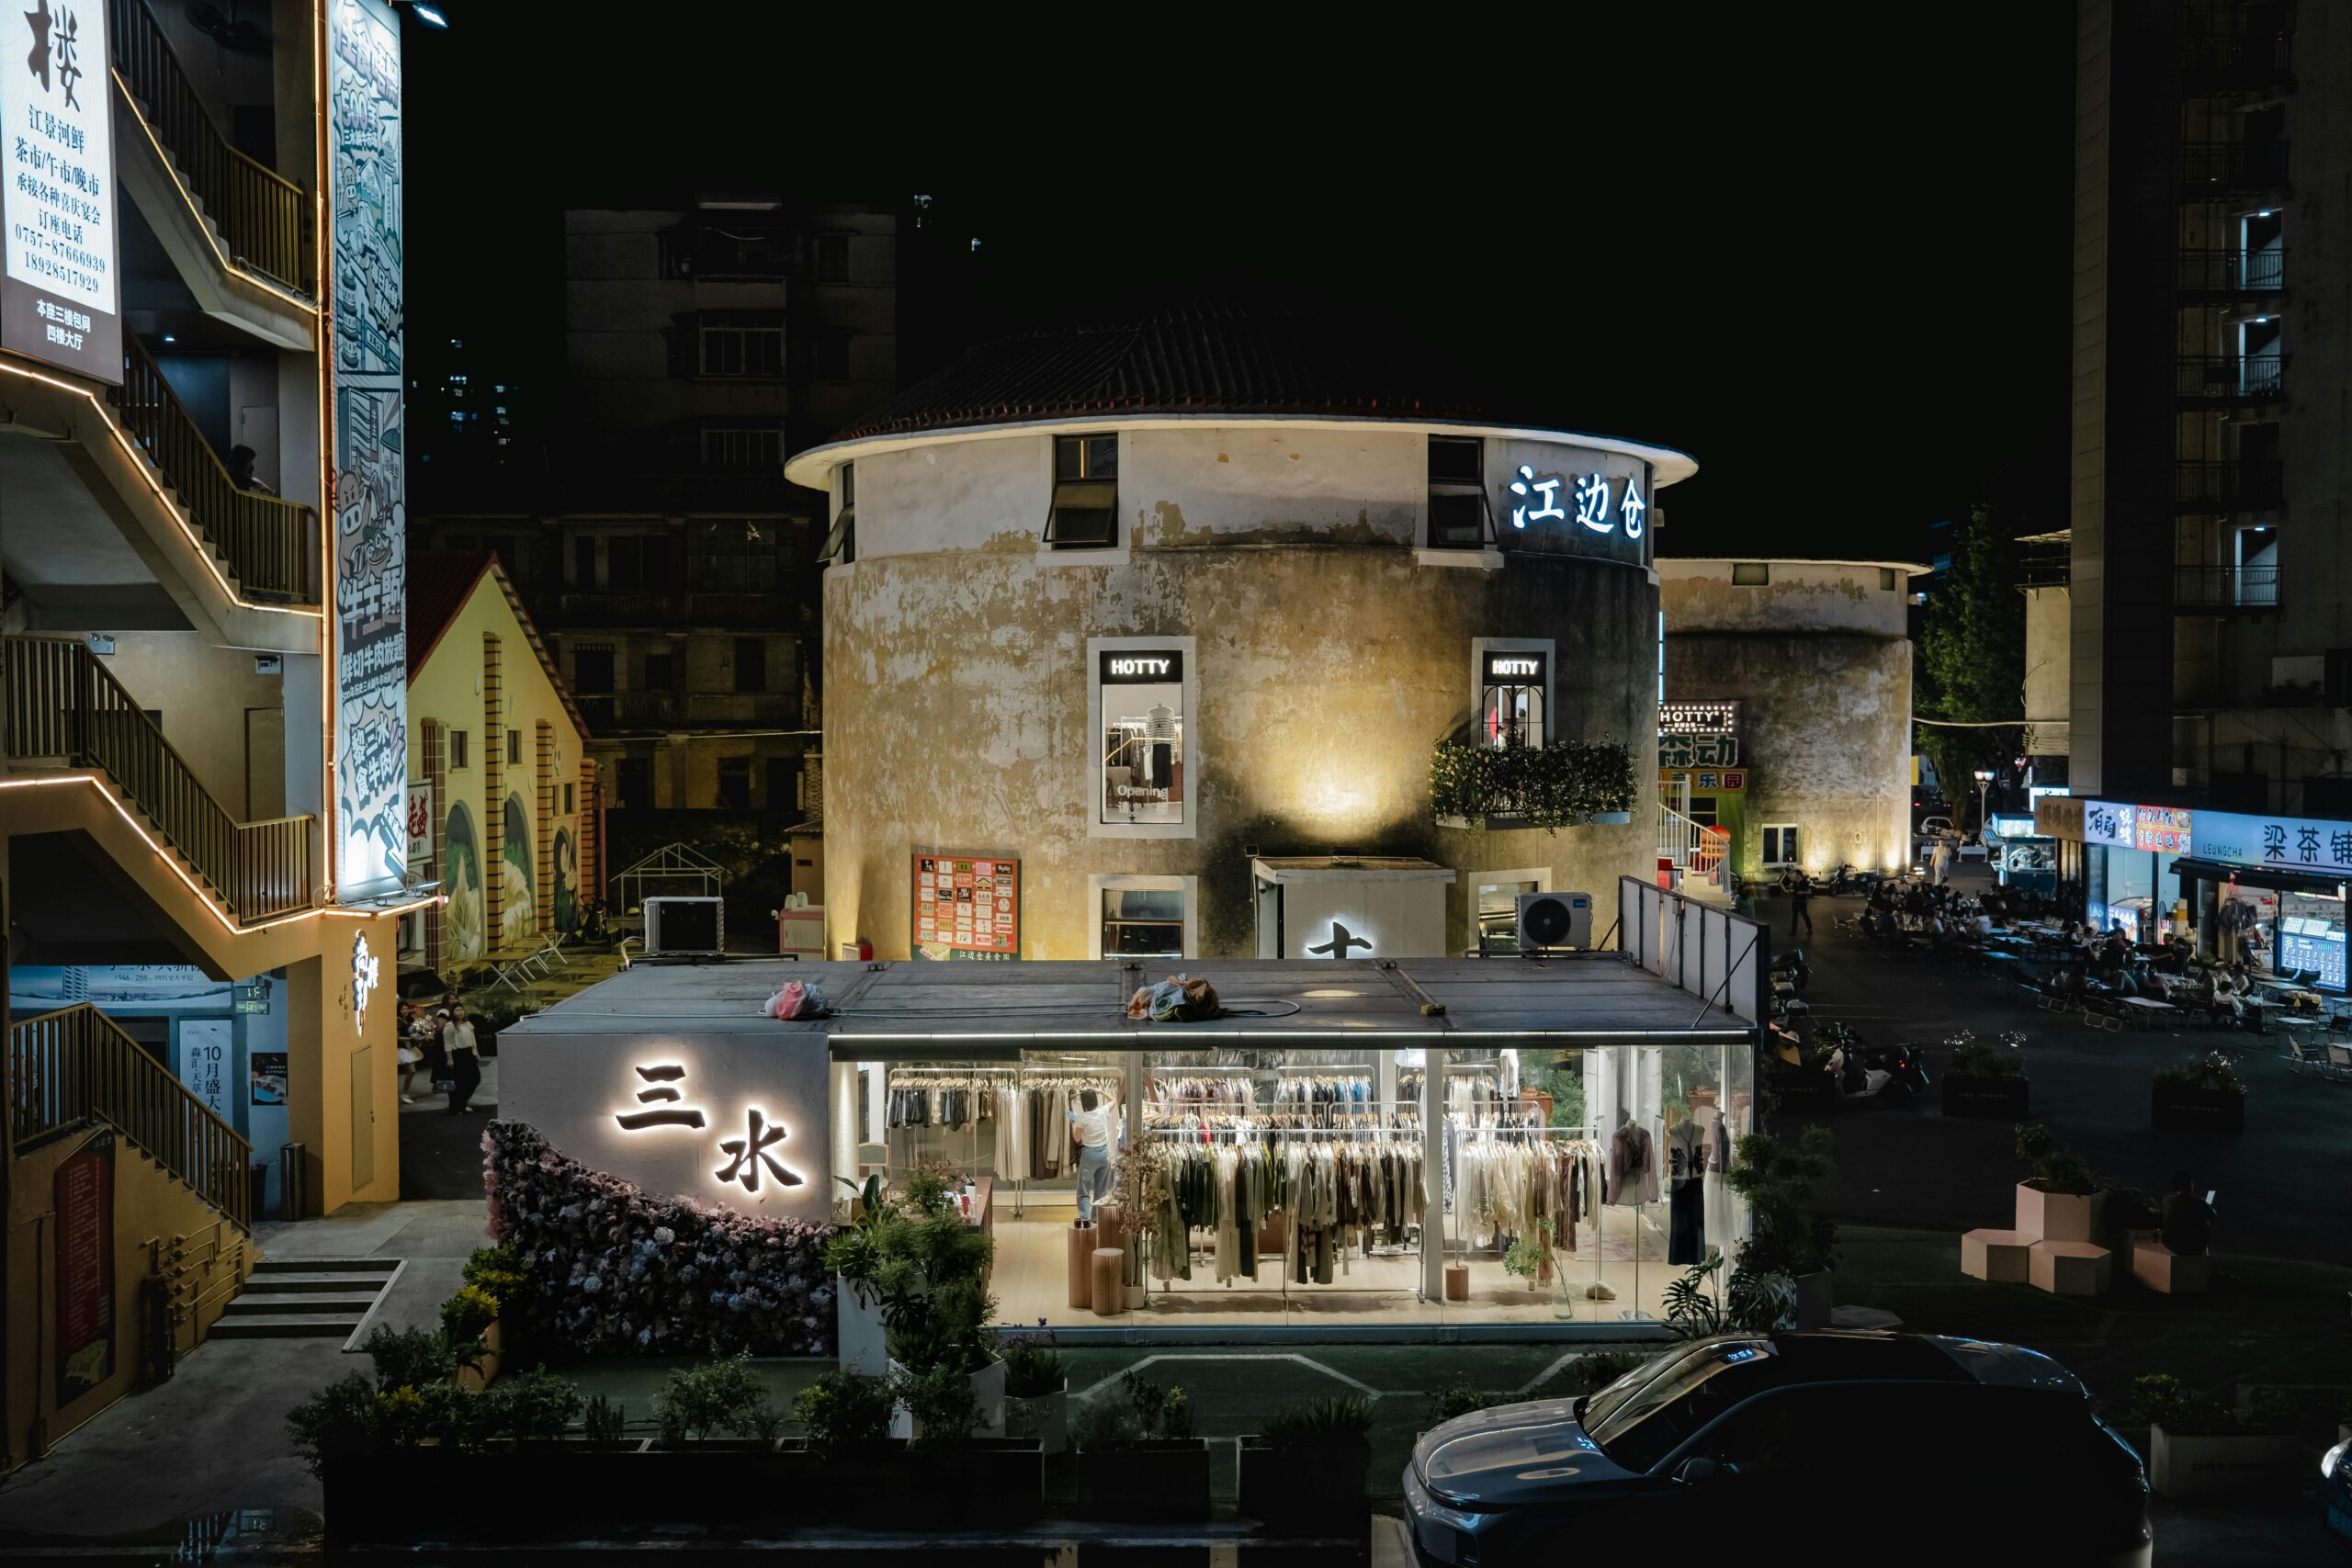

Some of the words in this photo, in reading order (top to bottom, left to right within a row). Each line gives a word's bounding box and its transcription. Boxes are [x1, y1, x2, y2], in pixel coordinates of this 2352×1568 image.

[24, 0, 82, 112] 楼
[28, 104, 85, 155] 江景河鲜
[15, 136, 99, 197] 茶市/午市/晚市
[17, 172, 101, 227] 承接各种喜庆宴会
[15, 223, 106, 275] 0757-87666939
[39, 209, 84, 245] 订座电话
[24, 252, 98, 294] 18928517929
[37, 299, 91, 333] 本座三楼包间
[47, 325, 84, 351] 四楼大厅
[1510, 465, 1645, 538] 江边仓
[343, 568, 401, 639] 牛主题
[341, 632, 404, 684] 鲜切牛肉放题
[1111, 660, 1170, 674] HOTTY
[1492, 660, 1539, 675] HOTTY
[1660, 711, 1714, 722] HOTTY
[1117, 784, 1169, 800] Opening
[2202, 843, 2243, 859] LEUNGCHA
[2264, 824, 2352, 864] 梁茶铺
[203, 1046, 221, 1118] 10月盛大
[615, 1064, 804, 1193] 三水
